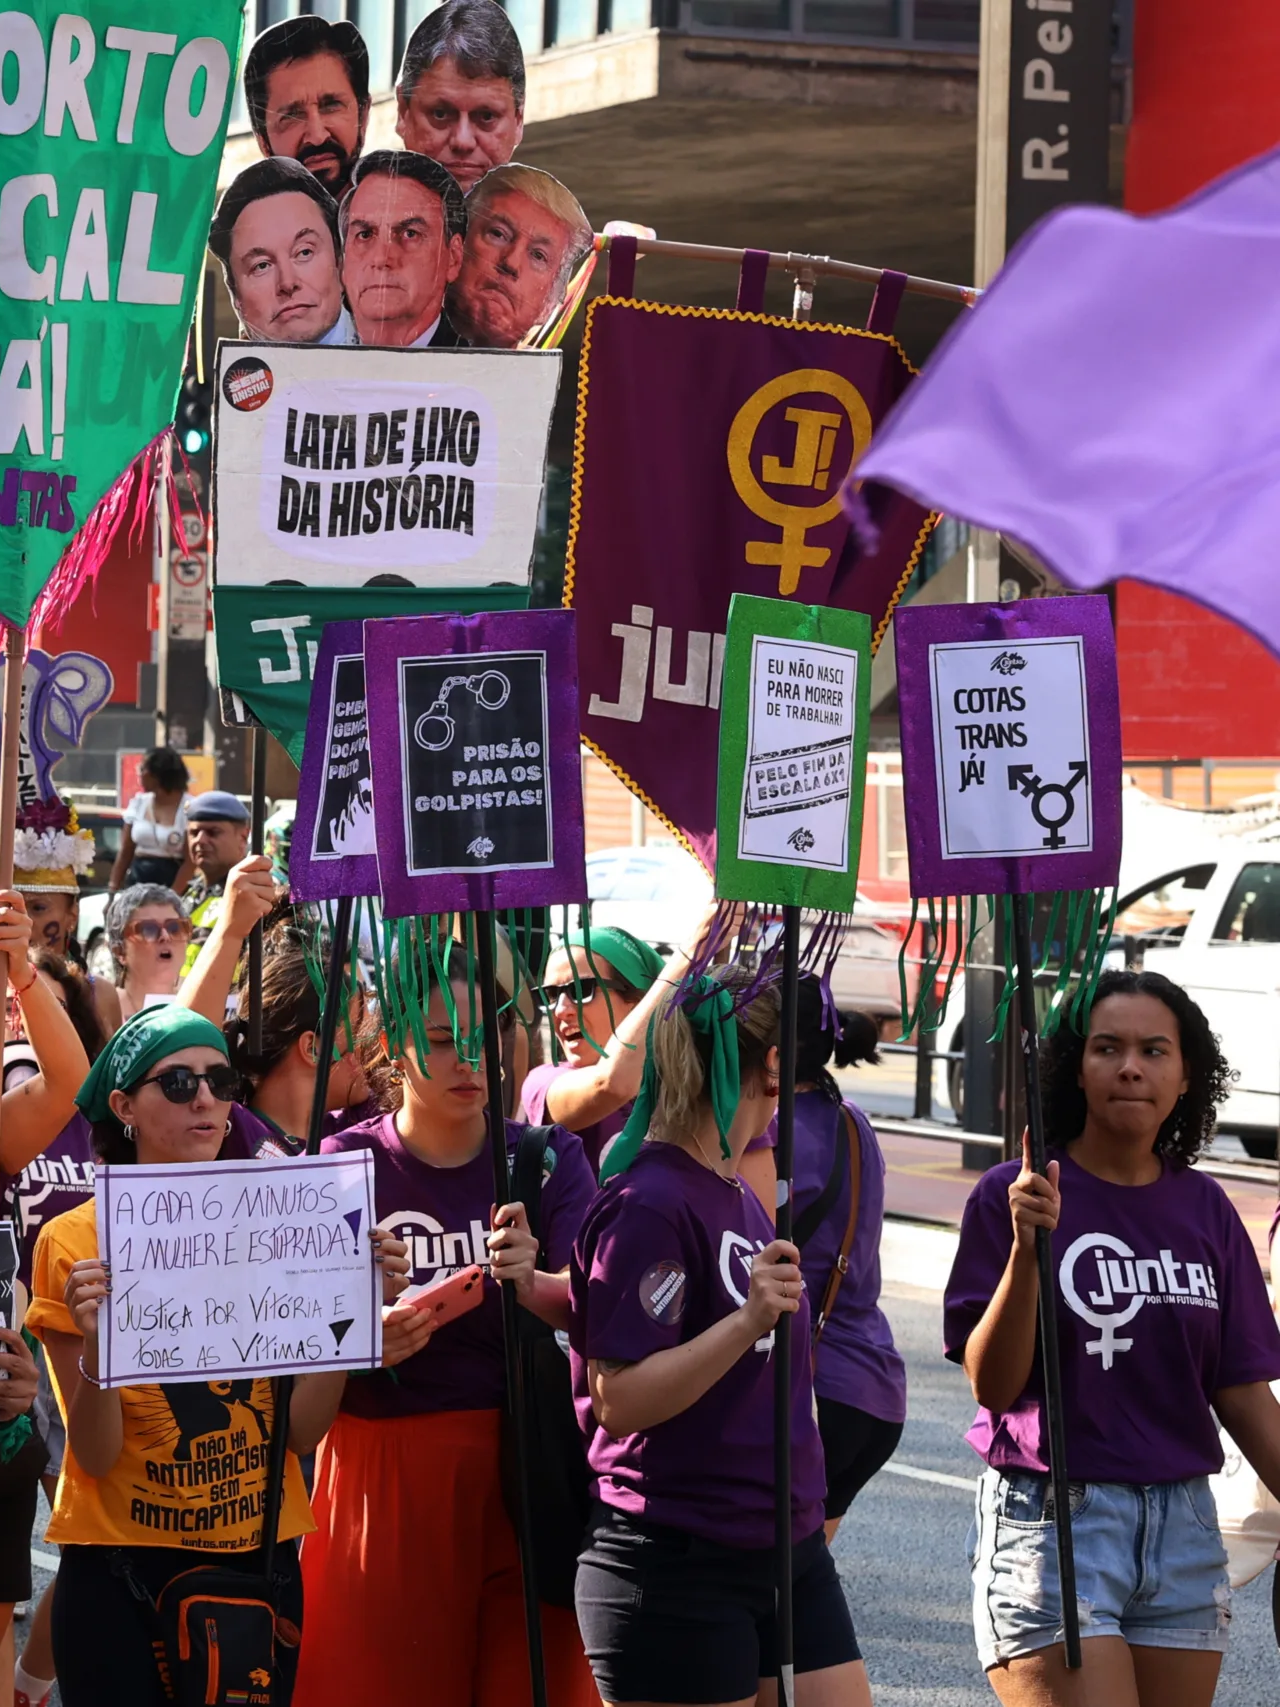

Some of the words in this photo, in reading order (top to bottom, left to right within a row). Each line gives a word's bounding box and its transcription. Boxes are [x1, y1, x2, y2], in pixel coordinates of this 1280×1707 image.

[1022, 124, 1070, 181] R.
[228, 369, 267, 394] SEM
[231, 379, 270, 405] ANISTIA!
[284, 407, 358, 471] LATA
[364, 408, 408, 468] DE
[411, 406, 480, 468] LIXO
[277, 474, 321, 537] DA
[327, 463, 475, 538] HISTÓRIA
[768, 658, 784, 675] EU
[788, 657, 814, 679] NÃO
[817, 665, 844, 685] NASCI
[767, 680, 800, 700] PARA
[805, 685, 843, 708] MORRER
[953, 686, 1026, 714] COTAS
[766, 702, 781, 717] DE
[786, 704, 842, 726] TRABALHAR!
[463, 737, 541, 763] PRISÃO
[955, 722, 1028, 750] TRANS
[452, 767, 508, 787] PARA
[511, 765, 543, 782] OS
[755, 763, 798, 784] PELO
[803, 756, 826, 774] FIM
[828, 751, 845, 769] DA
[959, 752, 985, 793] JÁ!
[414, 789, 543, 812] GOLPISTAS!
[758, 775, 820, 801] ESCALA
[116, 1191, 134, 1225] A
[141, 1190, 194, 1226] CADA
[201, 1184, 223, 1221] 6
[118, 1236, 135, 1273] 1
[141, 1232, 220, 1271] MULHER
[224, 1224, 239, 1266] É
[650, 1270, 678, 1303] FEMINISTA
[652, 1272, 686, 1316] ANTIRRACISTA
[204, 1297, 238, 1327] POR
[333, 1294, 346, 1317] E
[1146, 1295, 1162, 1304] POR
[1163, 1295, 1176, 1304] UM
[1177, 1295, 1204, 1307] FUTURO
[196, 1345, 221, 1368] AS
[196, 1435, 227, 1460] NÃO
[230, 1427, 247, 1450] HÁ
[145, 1441, 270, 1488] ANTIRRACISM
[210, 1478, 240, 1502] SEM
